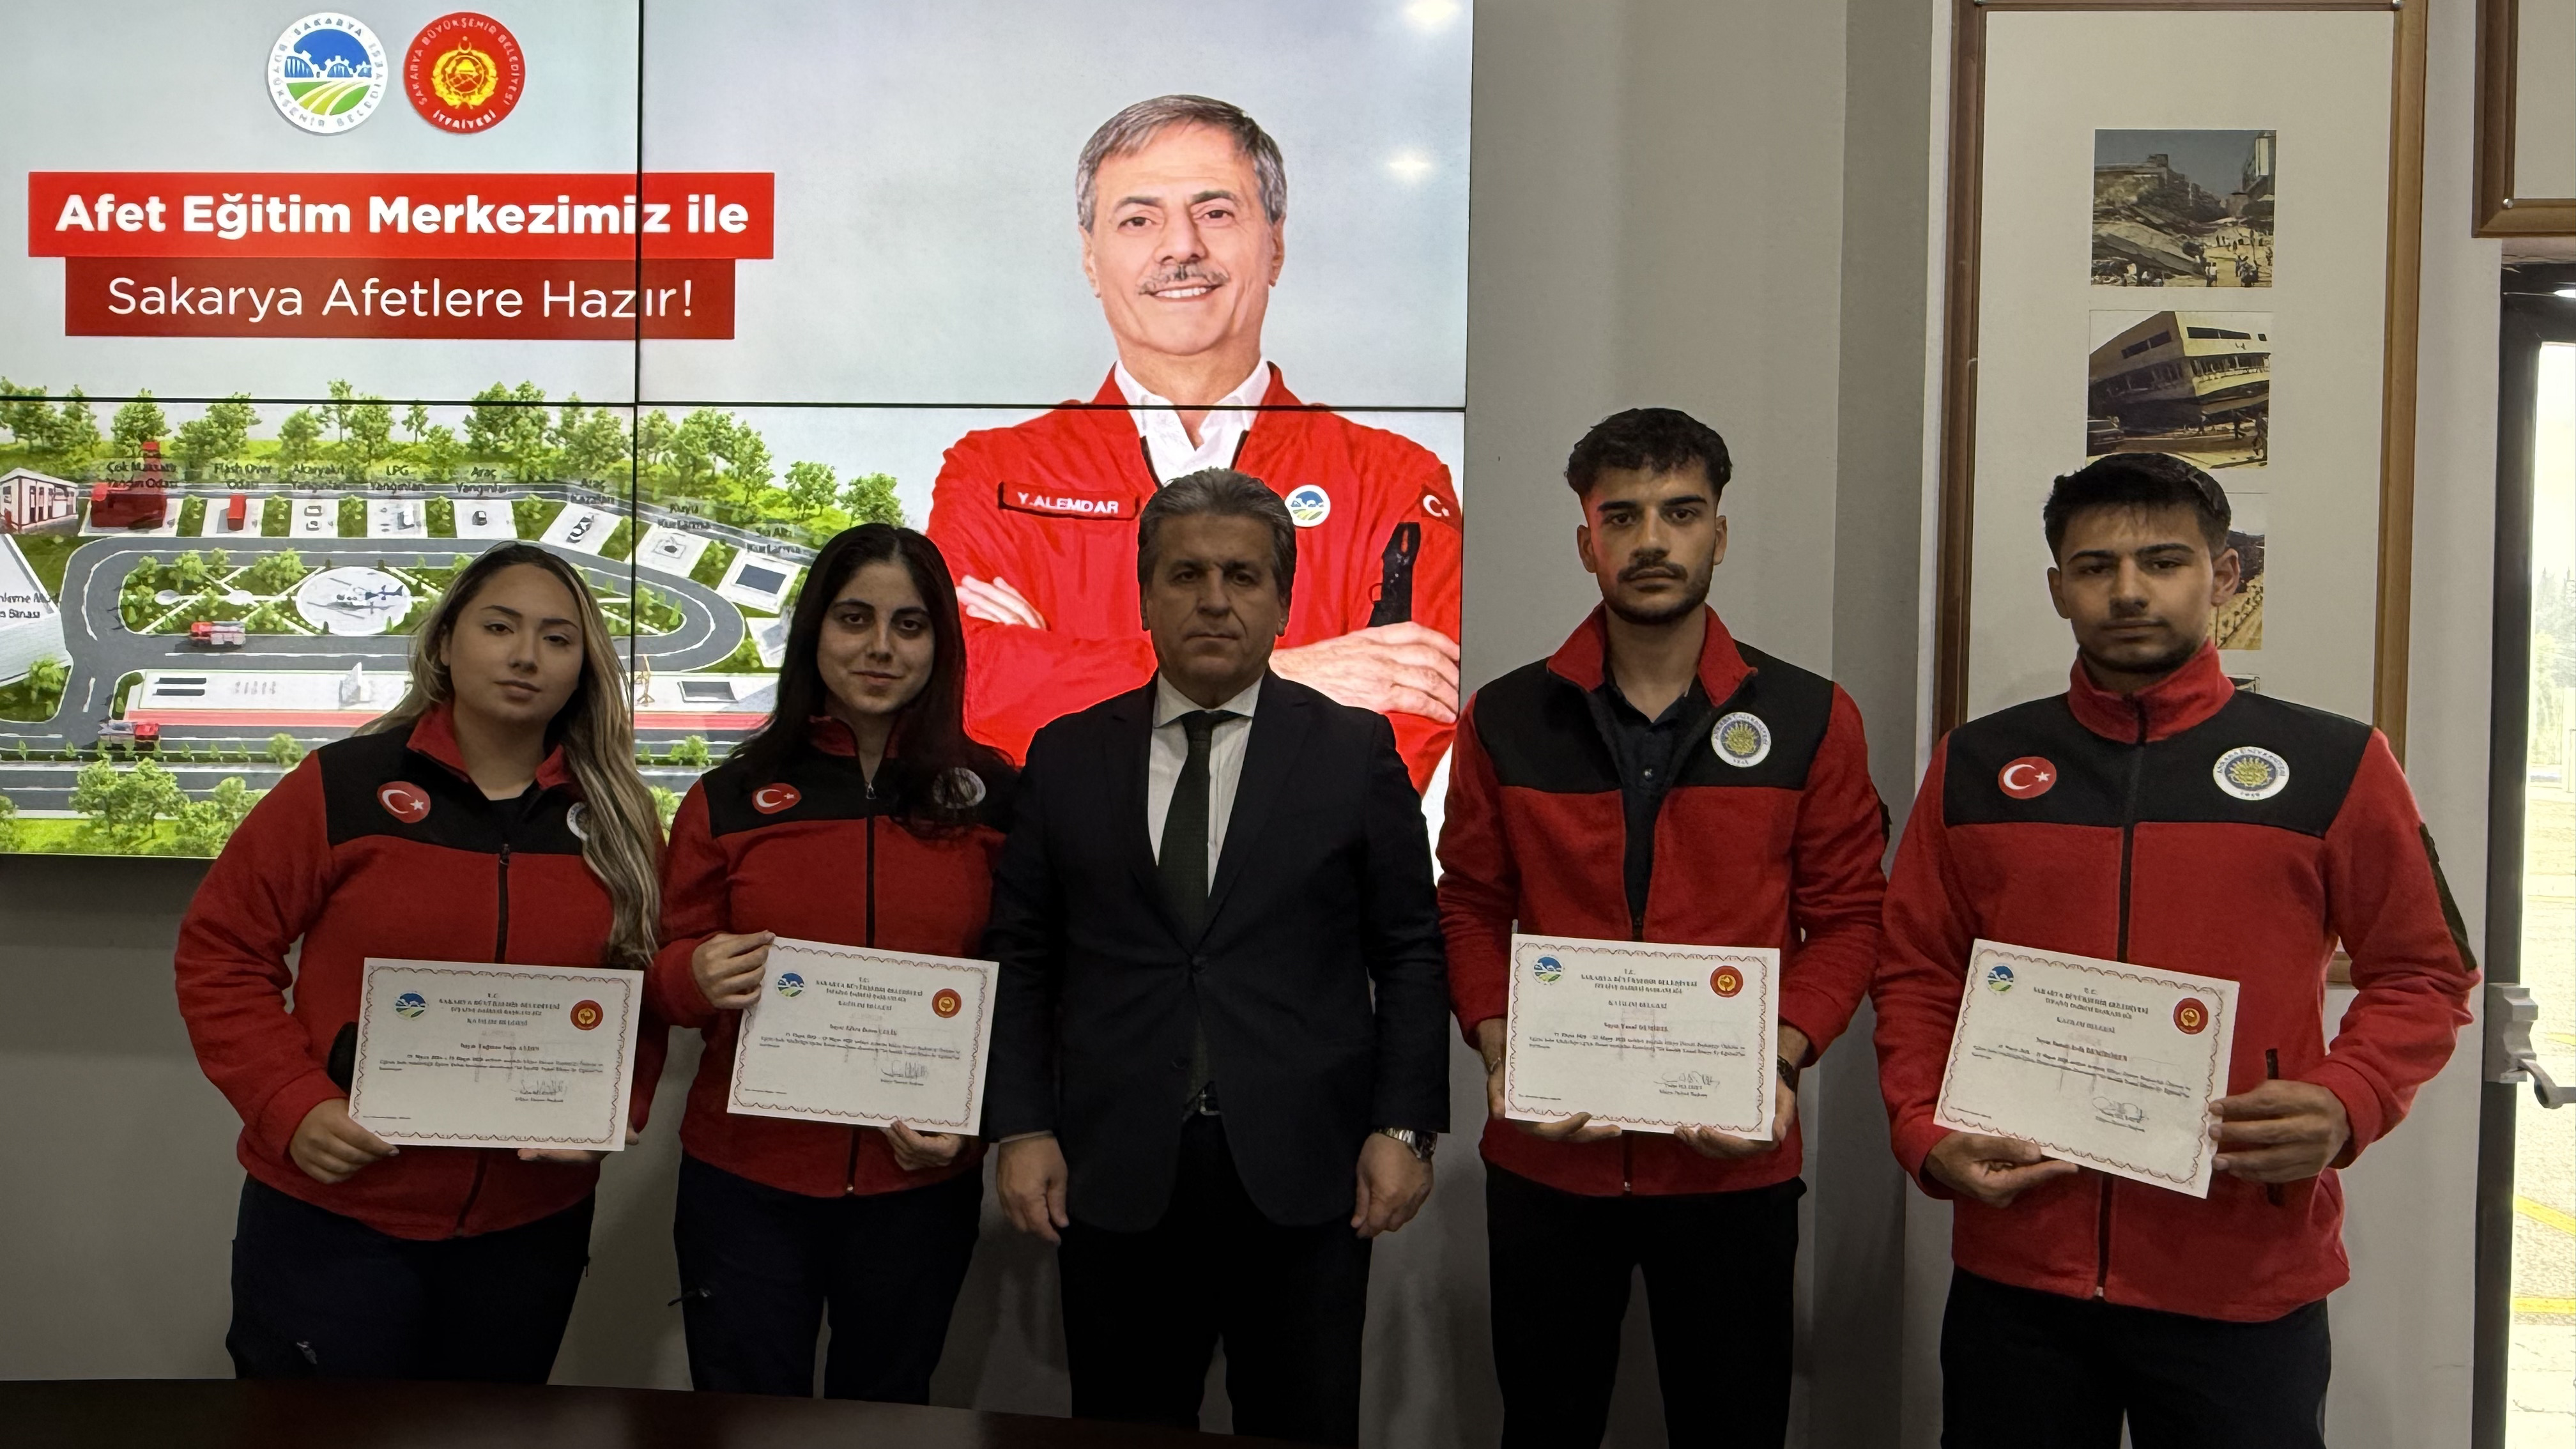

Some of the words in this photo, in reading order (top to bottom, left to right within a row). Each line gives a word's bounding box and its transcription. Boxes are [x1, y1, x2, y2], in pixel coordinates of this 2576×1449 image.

[293, 17, 364, 37] SAKARYA
[55, 194, 166, 232] Afet
[183, 193, 350, 240] Eğitim
[369, 195, 671, 234] Merkezimiz
[687, 194, 749, 233] ile
[108, 276, 302, 323] Sakarya
[322, 277, 523, 318] Afetlere
[544, 279, 692, 318] Hazır!
[386, 464, 409, 477] LPG
[1017, 491, 1119, 514] Y.ALEMDAR
